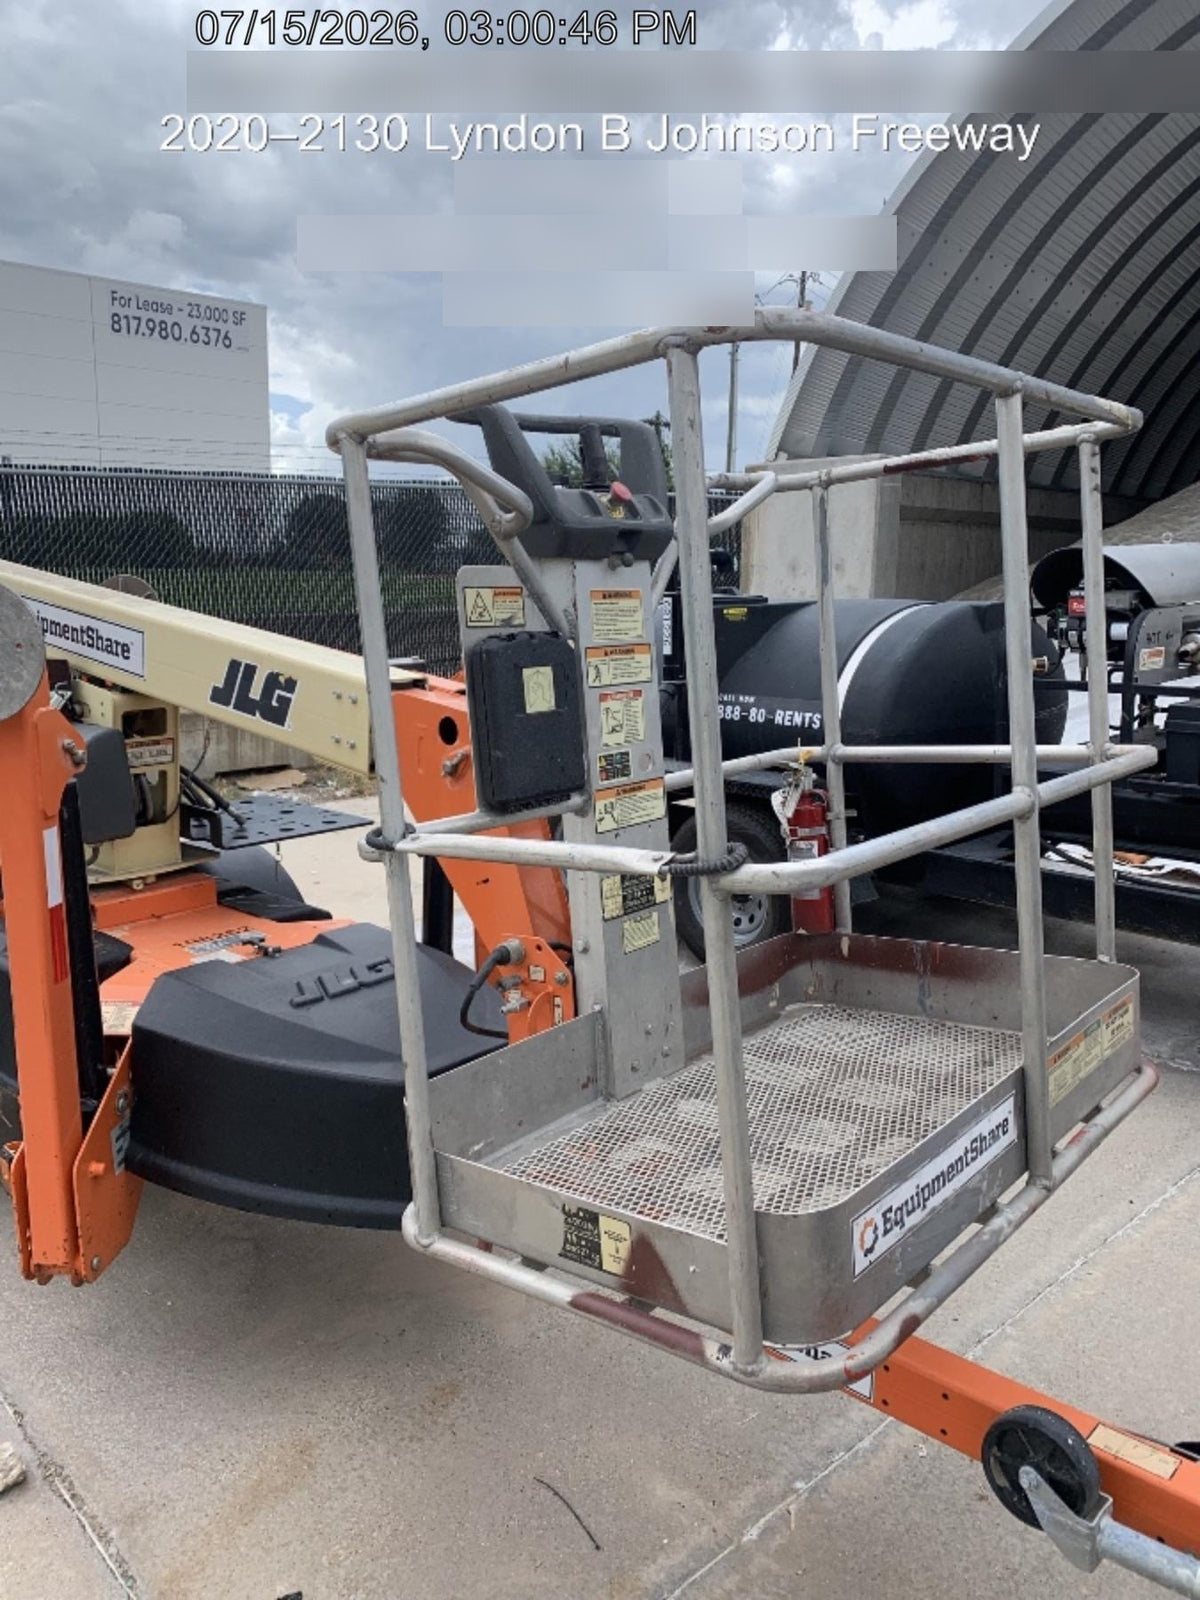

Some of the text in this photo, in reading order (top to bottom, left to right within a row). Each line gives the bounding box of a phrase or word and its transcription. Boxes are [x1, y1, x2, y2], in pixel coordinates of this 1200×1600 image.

[110, 290, 132, 308] For
[136, 295, 173, 315] Lease
[186, 302, 229, 324] 23,000
[232, 310, 247, 326] SF
[110, 312, 232, 349] 817.980.6376
[209, 658, 298, 727] JLG
[290, 955, 396, 1009] JLG
[881, 1117, 1009, 1238] EquipmentShare
